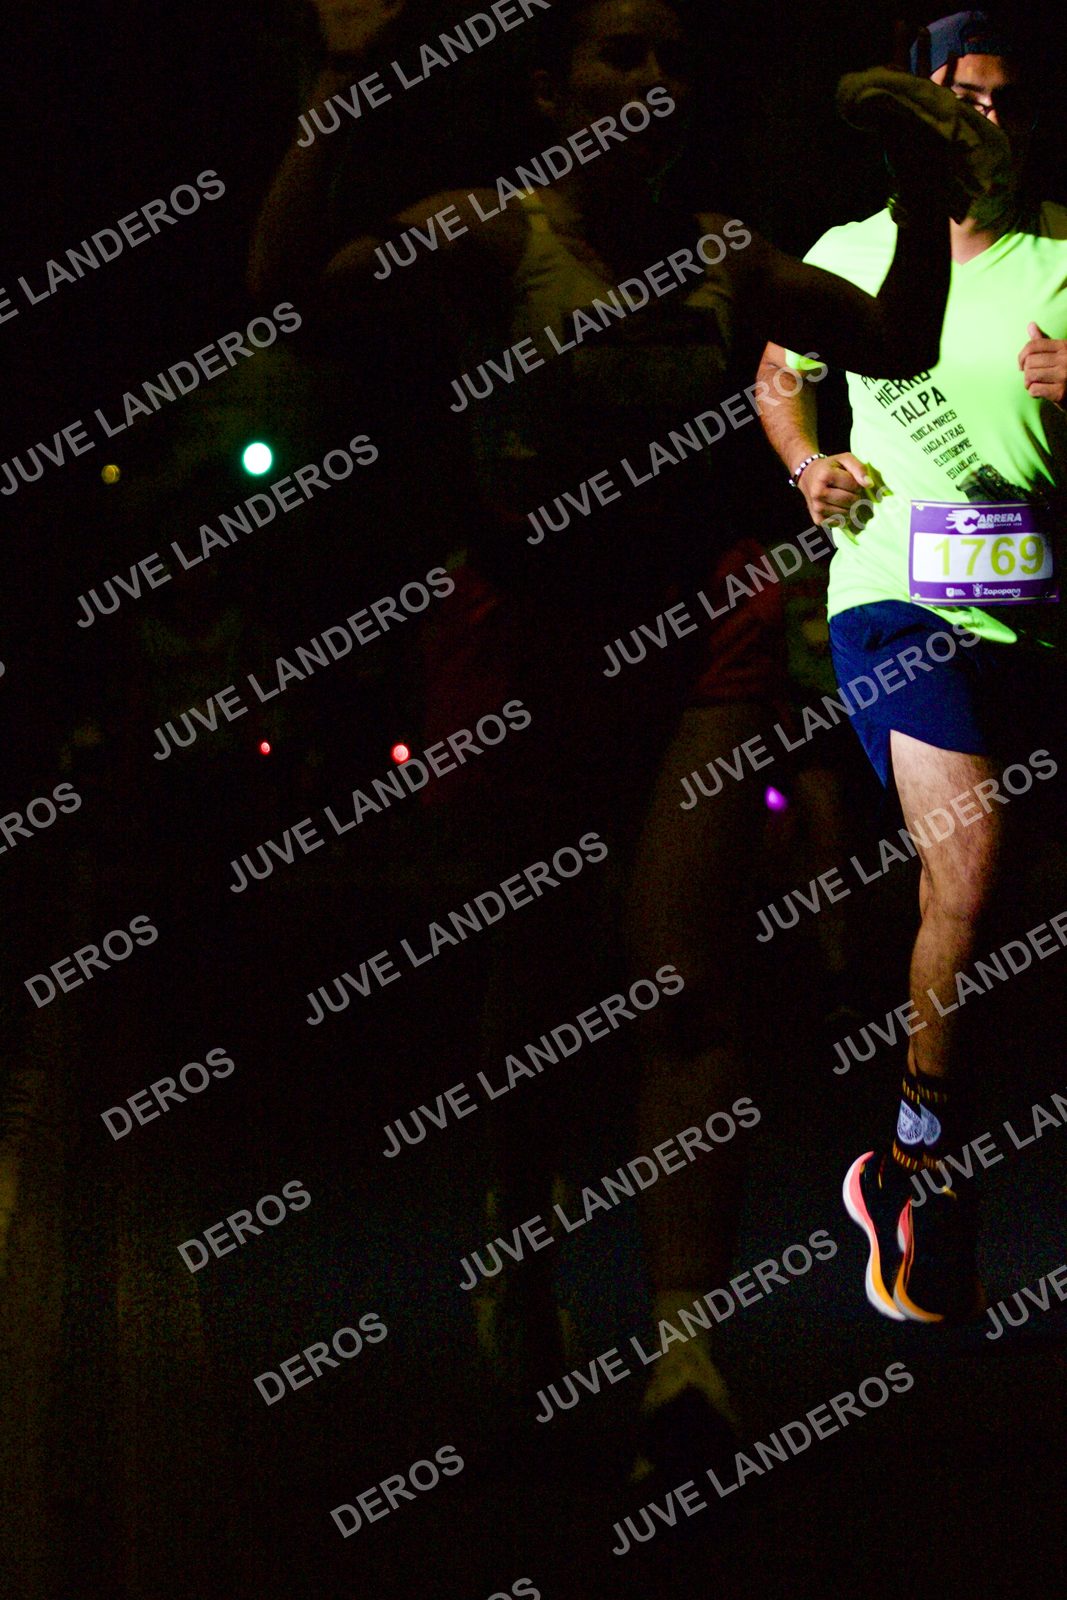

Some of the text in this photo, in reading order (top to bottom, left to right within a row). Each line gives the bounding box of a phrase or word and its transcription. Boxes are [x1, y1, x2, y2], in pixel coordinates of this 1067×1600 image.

[891, 386, 947, 428] TALPA
[910, 409, 958, 443] NUNCA MIRES
[941, 423, 966, 445] ATRAS
[945, 509, 1022, 534] CARRERA
[933, 536, 1044, 577] 1769
